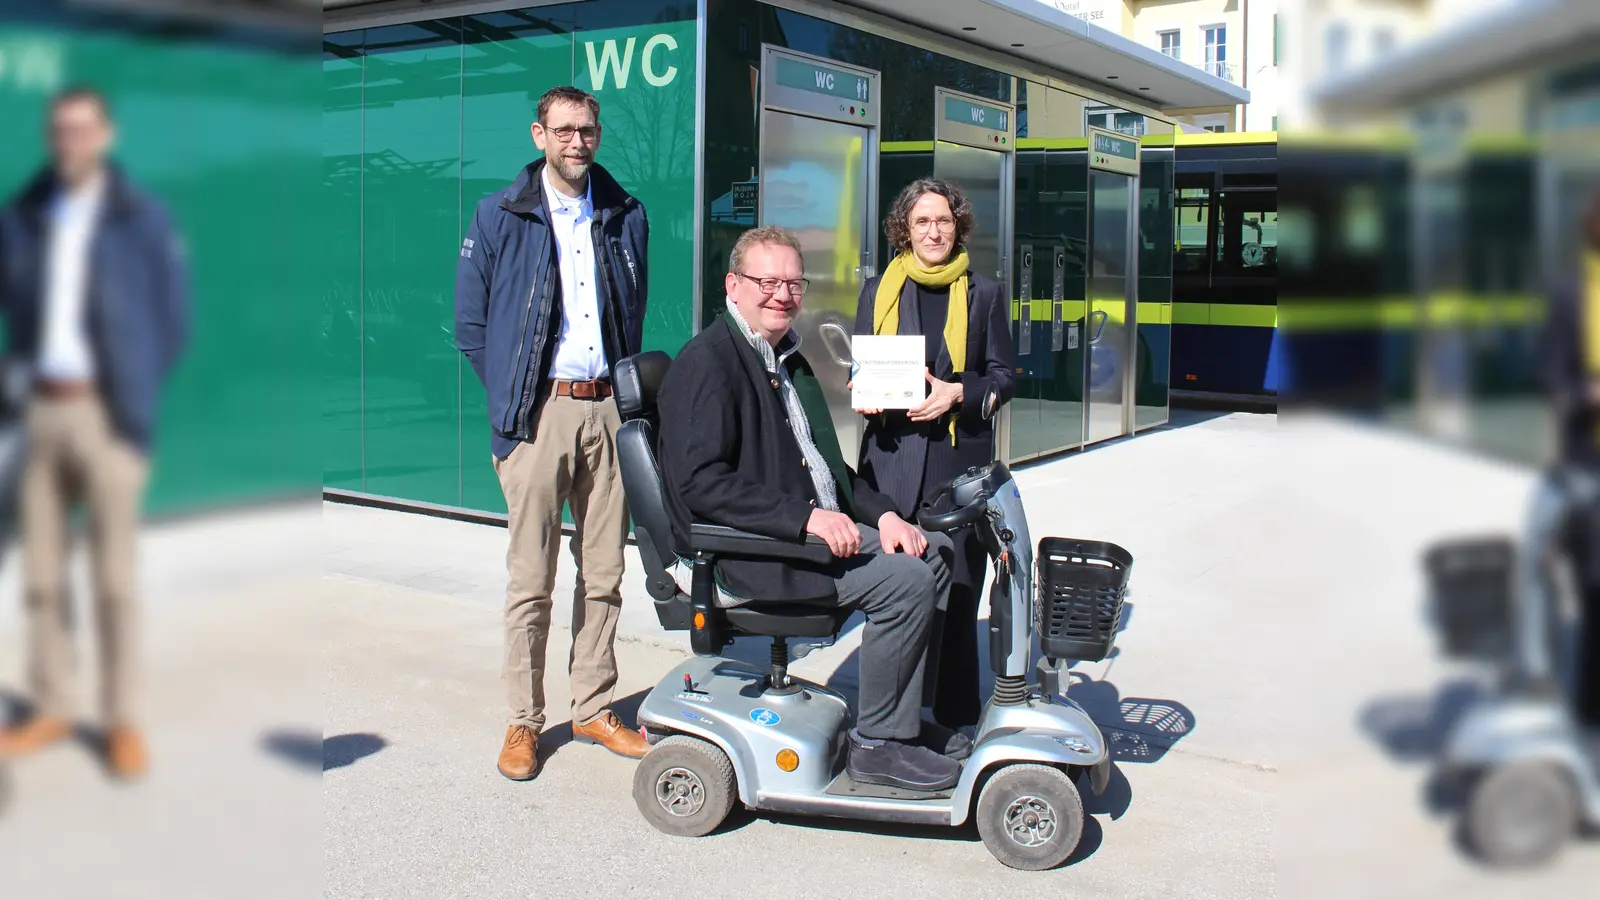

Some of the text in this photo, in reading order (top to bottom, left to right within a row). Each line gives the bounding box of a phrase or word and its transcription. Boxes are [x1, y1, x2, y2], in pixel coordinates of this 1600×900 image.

[585, 33, 678, 91] WC
[815, 71, 834, 90] WC
[971, 107, 985, 123] WC
[1111, 140, 1121, 153] WC
